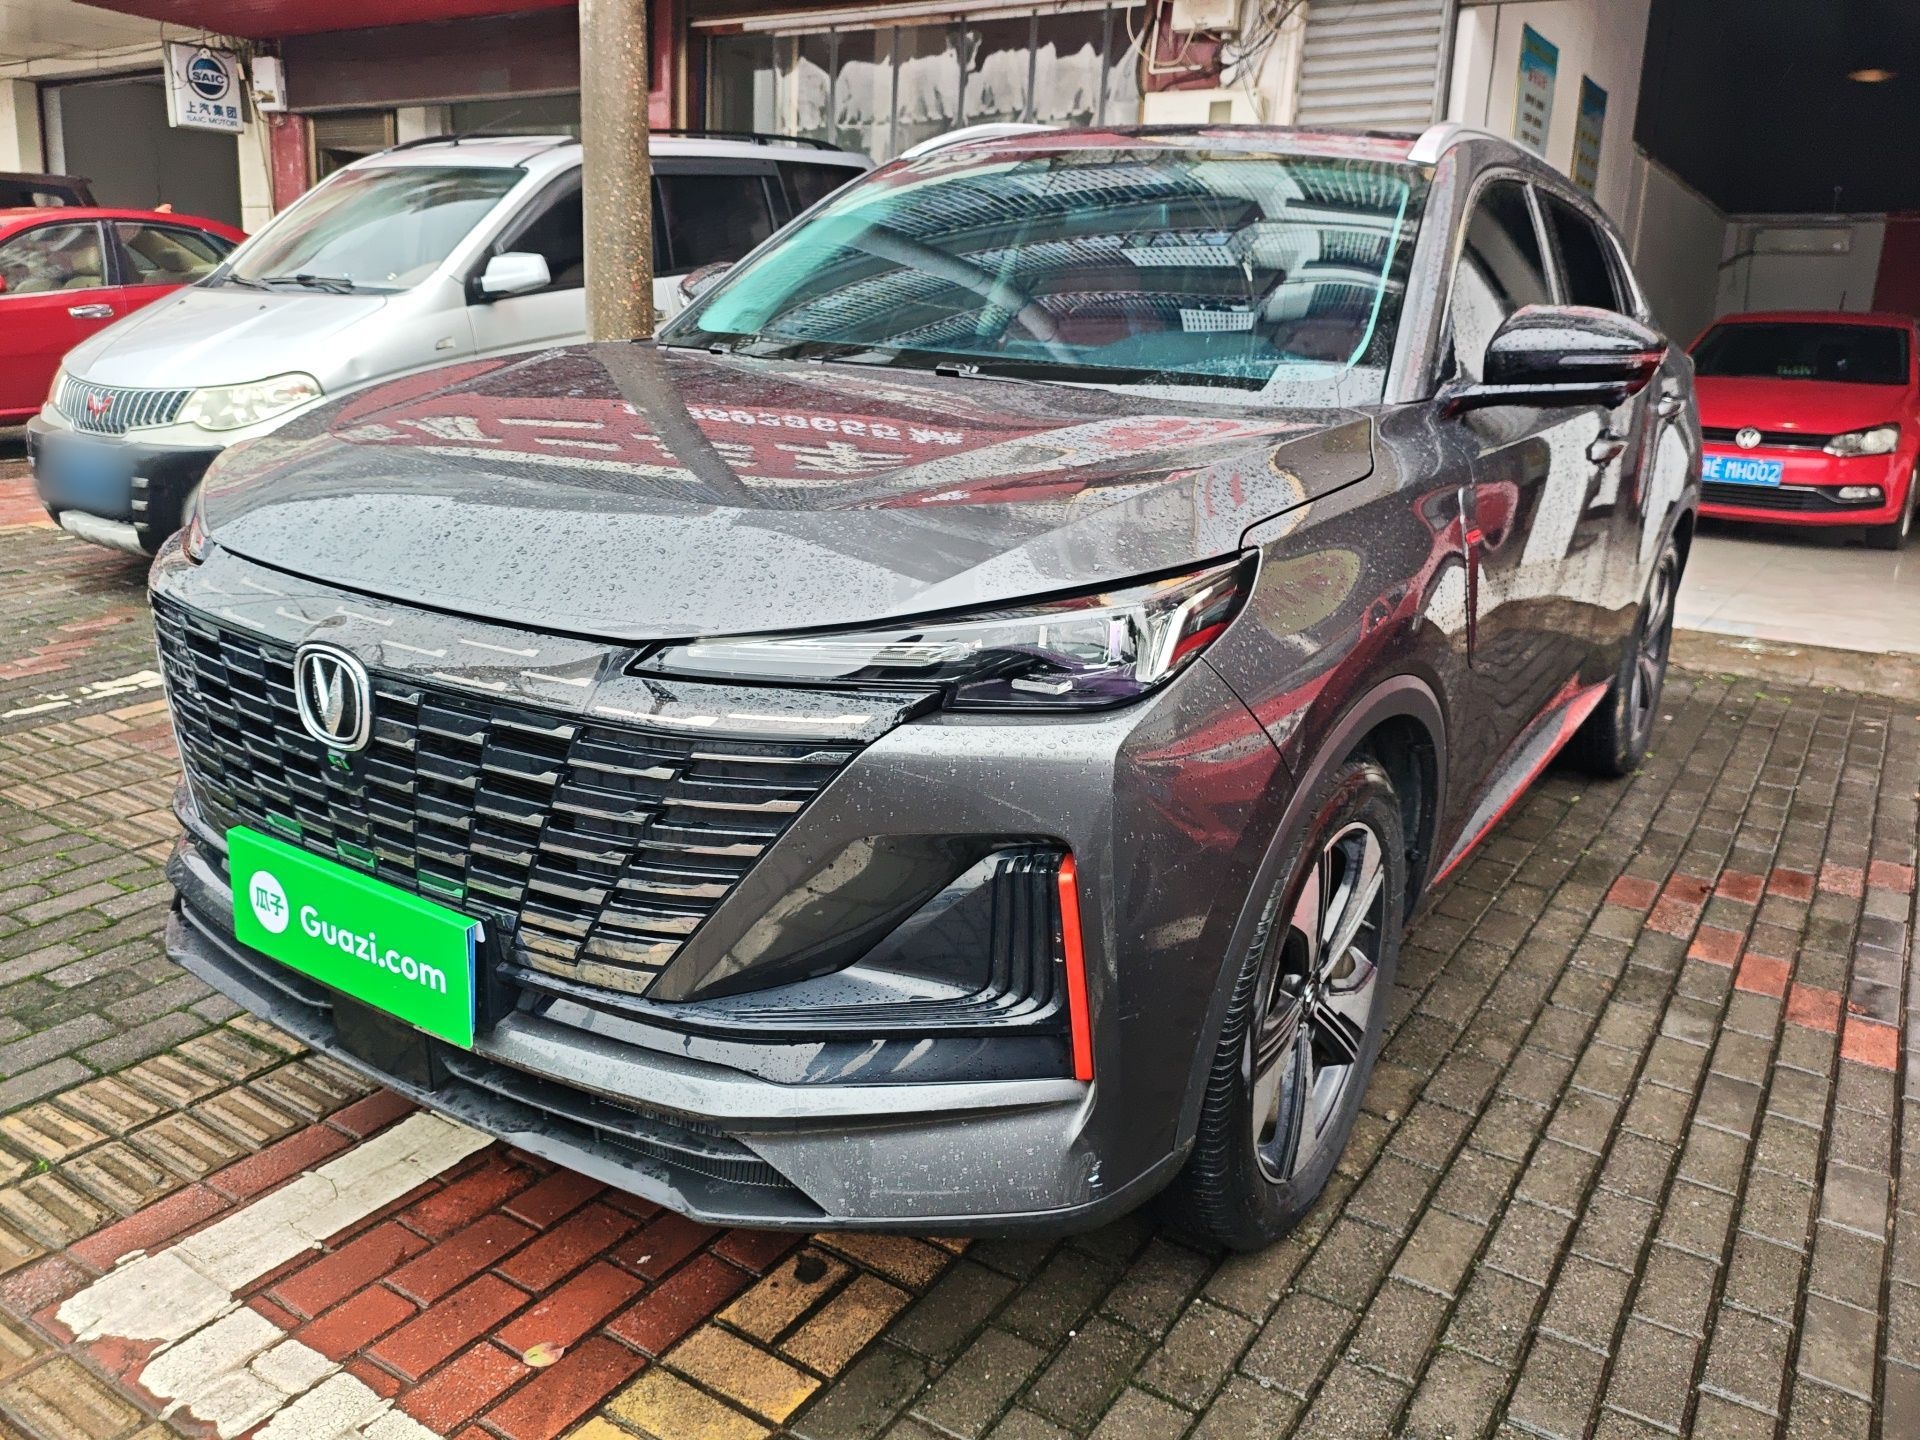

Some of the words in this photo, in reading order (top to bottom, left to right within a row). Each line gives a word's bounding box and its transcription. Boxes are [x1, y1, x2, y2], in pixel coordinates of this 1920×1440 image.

[193, 72, 225, 84] SAIC
[186, 101, 237, 118] 上汽集团
[255, 886, 285, 917] 瓜子
[299, 904, 448, 995] Guazi.com
